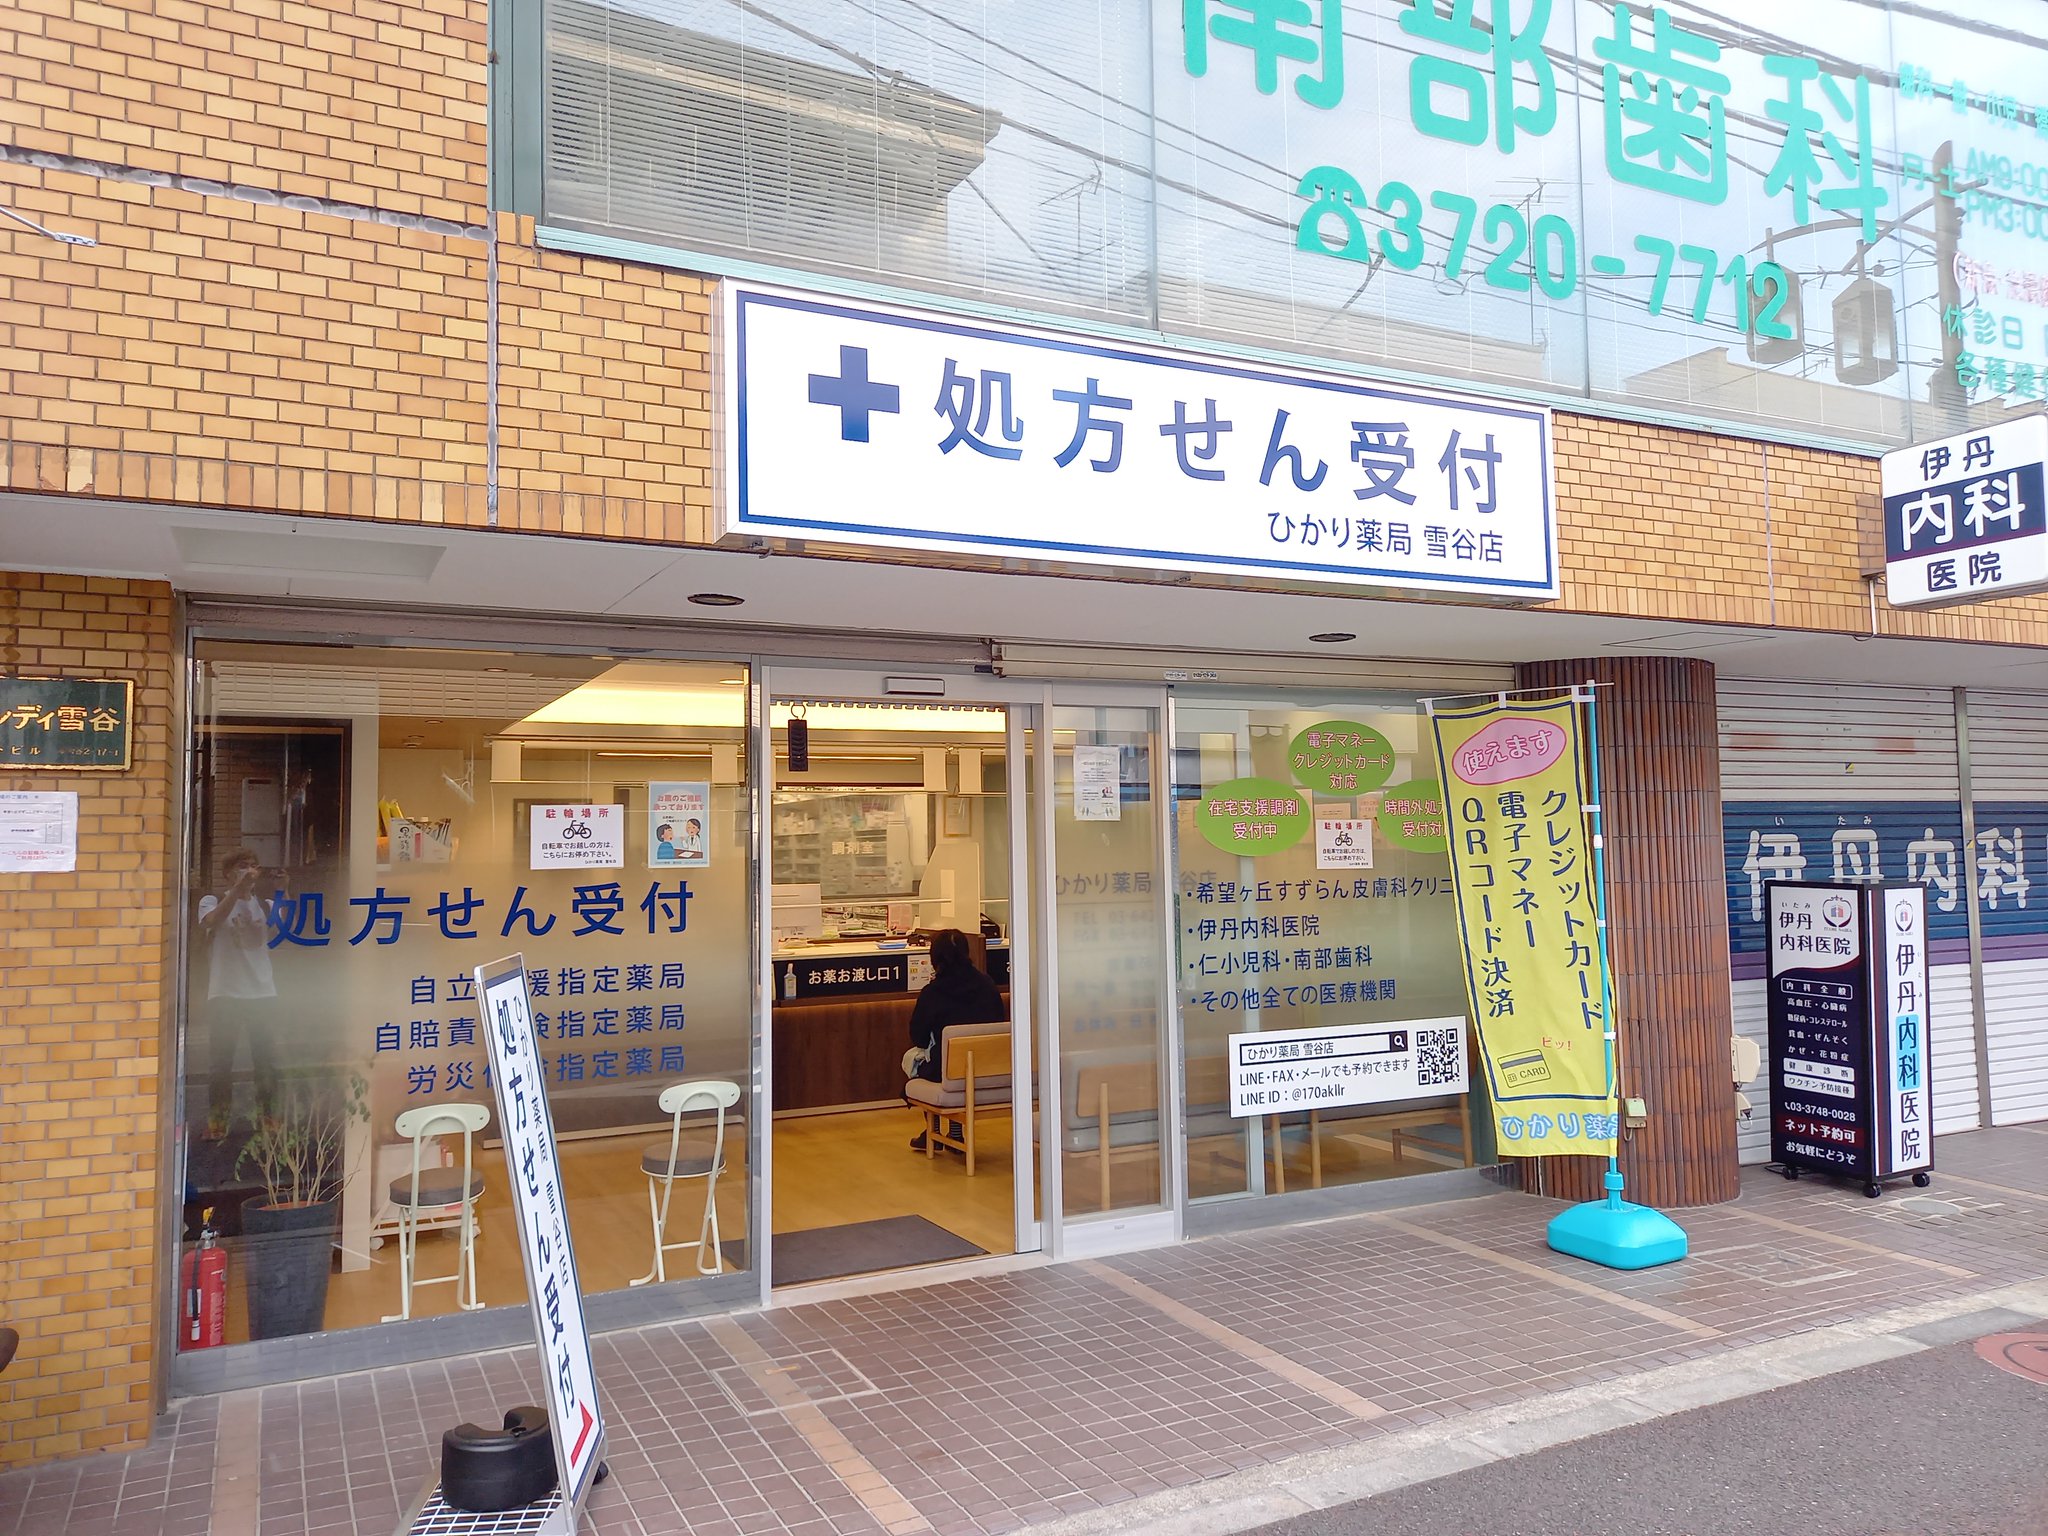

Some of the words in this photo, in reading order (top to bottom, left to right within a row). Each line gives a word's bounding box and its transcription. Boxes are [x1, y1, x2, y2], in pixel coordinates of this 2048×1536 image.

[1377, 181, 1793, 341] 3720-7712
[1943, 303, 2023, 350] 休診日
[934, 357, 1502, 515] 処方せん受付
[1920, 435, 1994, 482] 伊丹
[1902, 472, 2026, 551] 内科
[1268, 511, 1412, 557] ひかり薬局
[1424, 528, 1503, 565] 雪谷店
[1927, 551, 2002, 592] 医院
[1306, 732, 1376, 749] 電子マネー
[1463, 729, 1552, 775] 使えます
[1293, 752, 1391, 771] クレジットカード
[1329, 773, 1358, 790] 対応
[545, 808, 609, 818] 駐輪場所
[1208, 799, 1299, 817] 在宅支援調剤
[1232, 821, 1278, 839] 受付中
[1402, 821, 1446, 837] 受付対
[832, 841, 874, 855] 調剤室
[1497, 790, 1539, 948] 電子マネー
[1742, 827, 2031, 922] 伊丹内科
[1056, 872, 1152, 895] ひかり薬局
[265, 880, 693, 949] 処方せん受付
[1462, 797, 1515, 1018] QRコード決済
[1541, 790, 1603, 1030] クレジットカード
[1779, 911, 1812, 930] 伊丹
[1780, 933, 1851, 955] 内科医院
[410, 962, 686, 1006] 自立援指定薬局
[1786, 981, 1847, 996] 内科全般
[1787, 998, 1847, 1012] 高血圧・心臓病
[376, 1003, 686, 1053] 自賠責険指定薬局
[1788, 1029, 1848, 1045] 貧血・ぜんそく
[1247, 1044, 1300, 1061] ひかり薬局
[1303, 1041, 1334, 1056] 雪谷店
[1788, 1045, 1848, 1061] かぜ・花粉症
[1895, 943, 1921, 1163] 伊丹内科医院
[408, 1045, 686, 1095] 労災指定薬局
[1520, 1066, 1546, 1080] CARD
[1789, 1061, 1849, 1078] 健康診断
[1788, 1077, 1850, 1094] ワクチン予防接種
[1241, 1091, 1265, 1106] LINE
[1790, 1101, 1856, 1122] 03-3748-0028
[1785, 1118, 1856, 1143] ネット予約可
[1785, 1141, 1857, 1165] お気軽にどうぞ
[496, 999, 575, 1419] 処方せん受付
